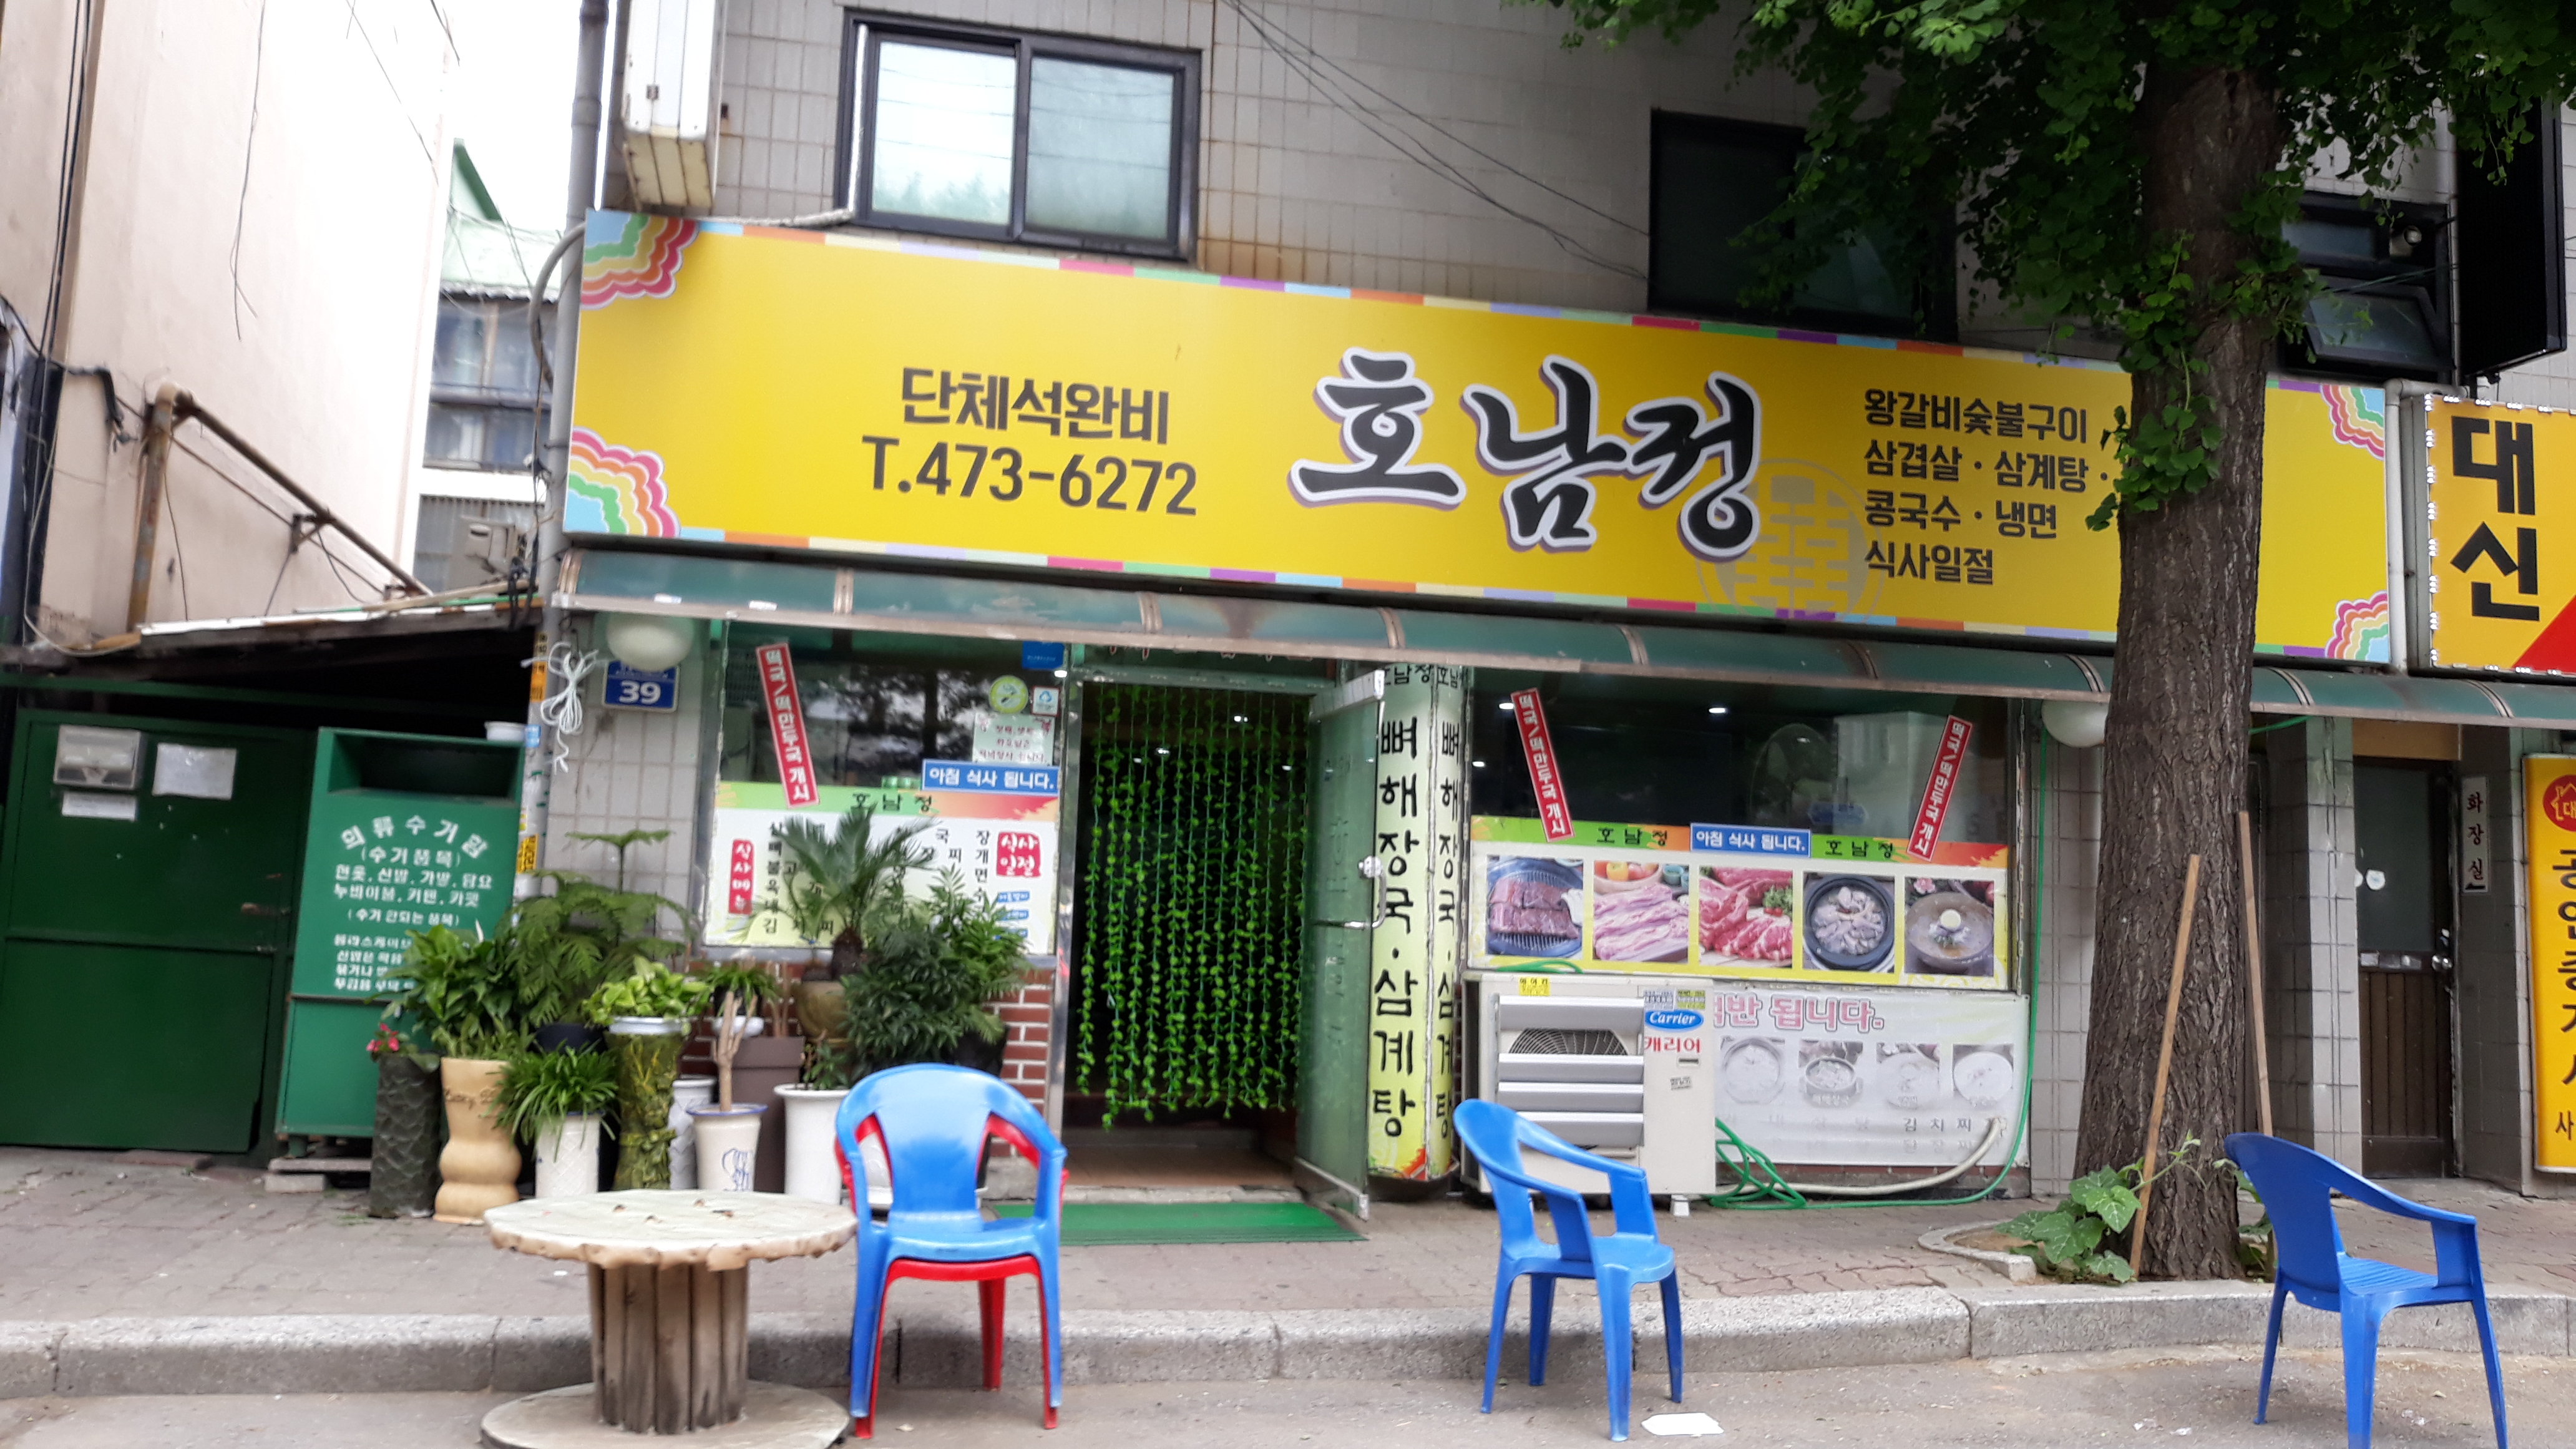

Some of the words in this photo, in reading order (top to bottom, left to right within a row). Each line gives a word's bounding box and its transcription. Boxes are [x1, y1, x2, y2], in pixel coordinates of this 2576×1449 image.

[902, 366, 1169, 445] 단체석완비
[1865, 388, 2087, 444] 왕갈비숯불구이
[1287, 346, 1760, 562] 호남정
[862, 434, 1197, 516] T.473-6272
[1996, 499, 2057, 540] 냉면
[2450, 415, 2540, 622] 대신
[1865, 540, 1994, 586] 식사일절
[618, 680, 661, 704] 39
[789, 766, 810, 801] 개시
[929, 767, 960, 786] 아침
[967, 769, 998, 788] 식사
[1004, 771, 1054, 790] 됩니다.
[1546, 803, 1566, 834] 개시
[1001, 833, 1037, 853] 식사
[1596, 827, 1667, 846] 호남정
[1695, 831, 1723, 847] 아침
[1729, 831, 1755, 849] 식사
[1761, 834, 1805, 851] 됩니다.
[1825, 840, 1893, 859] 호남정
[1915, 822, 1934, 856] 개시
[2467, 792, 2484, 881] 화장실
[1649, 1011, 1696, 1025] Carrier
[1644, 1036, 1702, 1053] 캐리어
